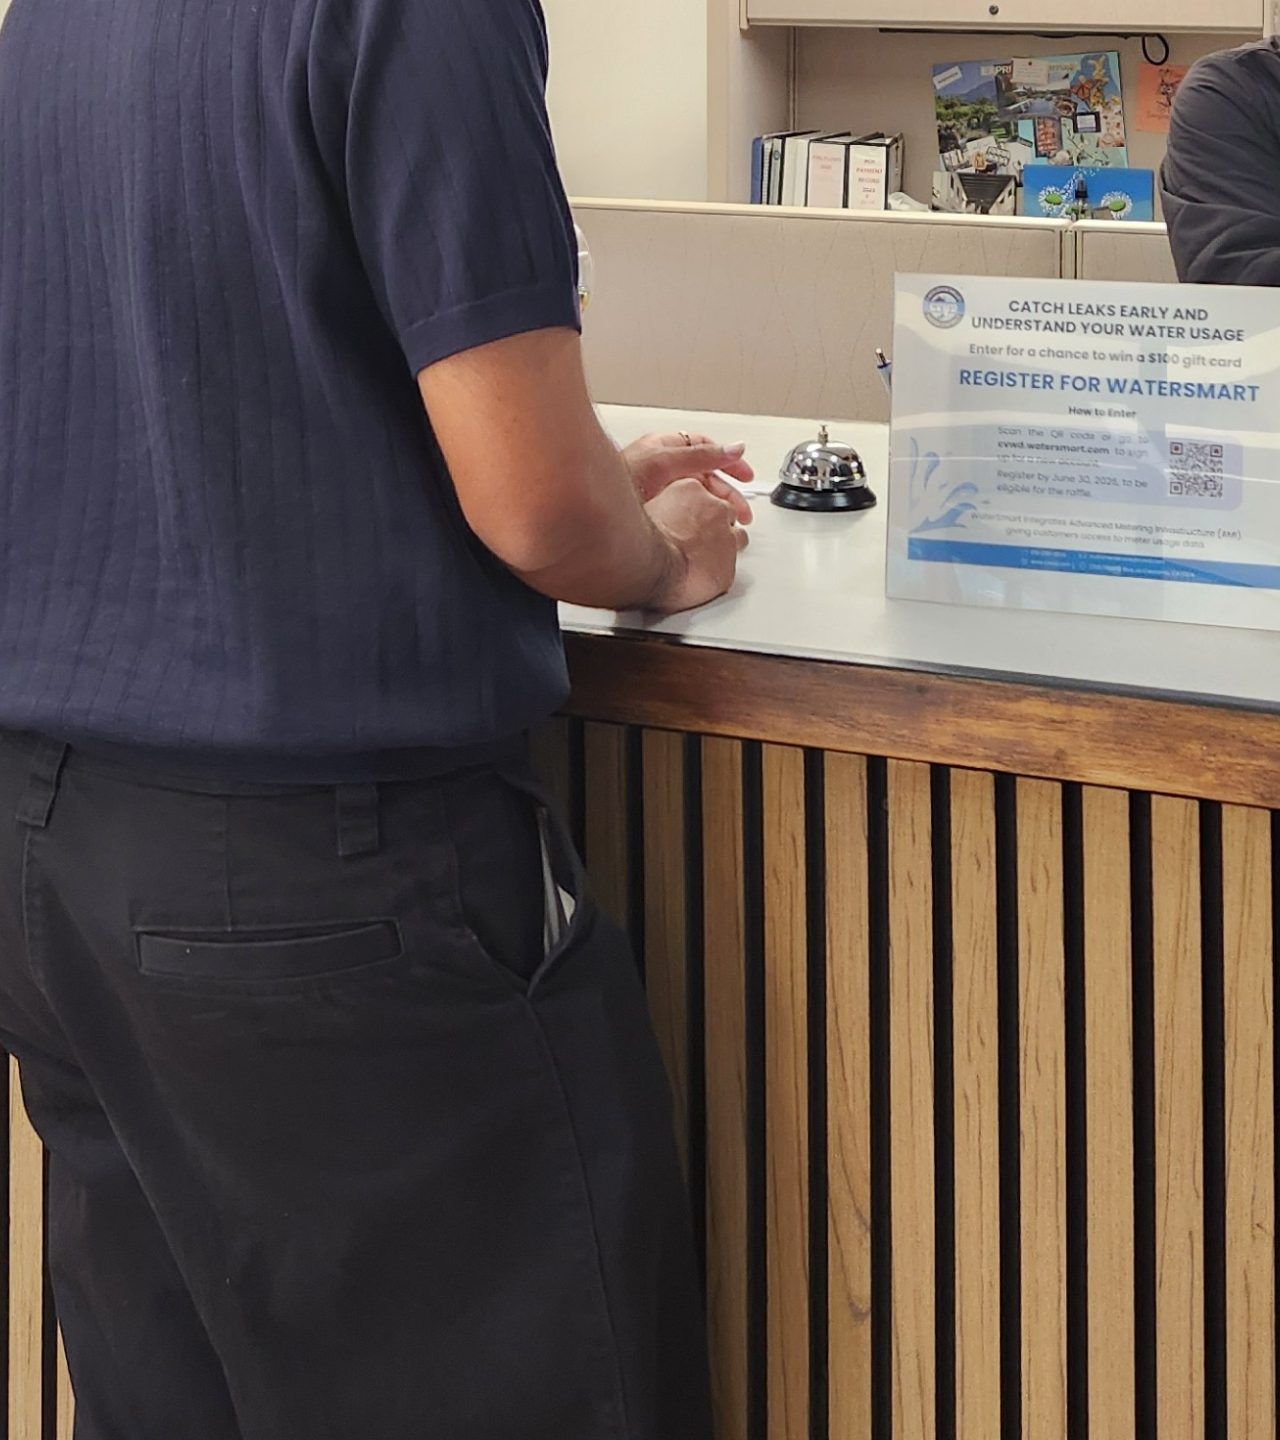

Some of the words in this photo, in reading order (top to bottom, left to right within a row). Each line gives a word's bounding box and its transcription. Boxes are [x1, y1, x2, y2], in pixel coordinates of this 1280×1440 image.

[1009, 300, 1064, 315] CATCH
[1068, 303, 1116, 317] LEAKS
[1121, 305, 1169, 319] EARLY
[1173, 308, 1209, 321] AND
[972, 317, 1076, 333] UNDERSTAND
[1080, 321, 1124, 337] YOUR
[1128, 324, 1185, 339] WATER
[1190, 327, 1245, 342] USAGE
[969, 344, 1004, 355] Enter
[1007, 344, 1024, 356] for
[1027, 348, 1036, 357] a
[1039, 347, 1089, 360] chance
[1092, 350, 1106, 361] to
[1108, 351, 1133, 362] win
[1148, 352, 1180, 364] $100
[1182, 354, 1207, 369] gift
[1209, 356, 1242, 368] card
[960, 369, 1054, 389] REGISTER
[1060, 374, 1100, 392] FOR
[1106, 377, 1260, 402] WATERSMART
[1068, 406, 1092, 416] How
[1095, 407, 1105, 417] to
[1108, 408, 1137, 418] Enter
[998, 426, 1022, 435] Scan
[1028, 428, 1044, 437] the
[1070, 431, 1096, 440] code
[998, 440, 1110, 455] cvwd.watersmart.com
[996, 470, 1035, 481] Register
[1037, 472, 1049, 482] by
[1052, 473, 1075, 483] June
[1122, 478, 1133, 487] to
[1135, 479, 1148, 488] be
[996, 483, 1030, 494] eligible
[1033, 484, 1045, 494] for
[1048, 486, 1063, 496] the
